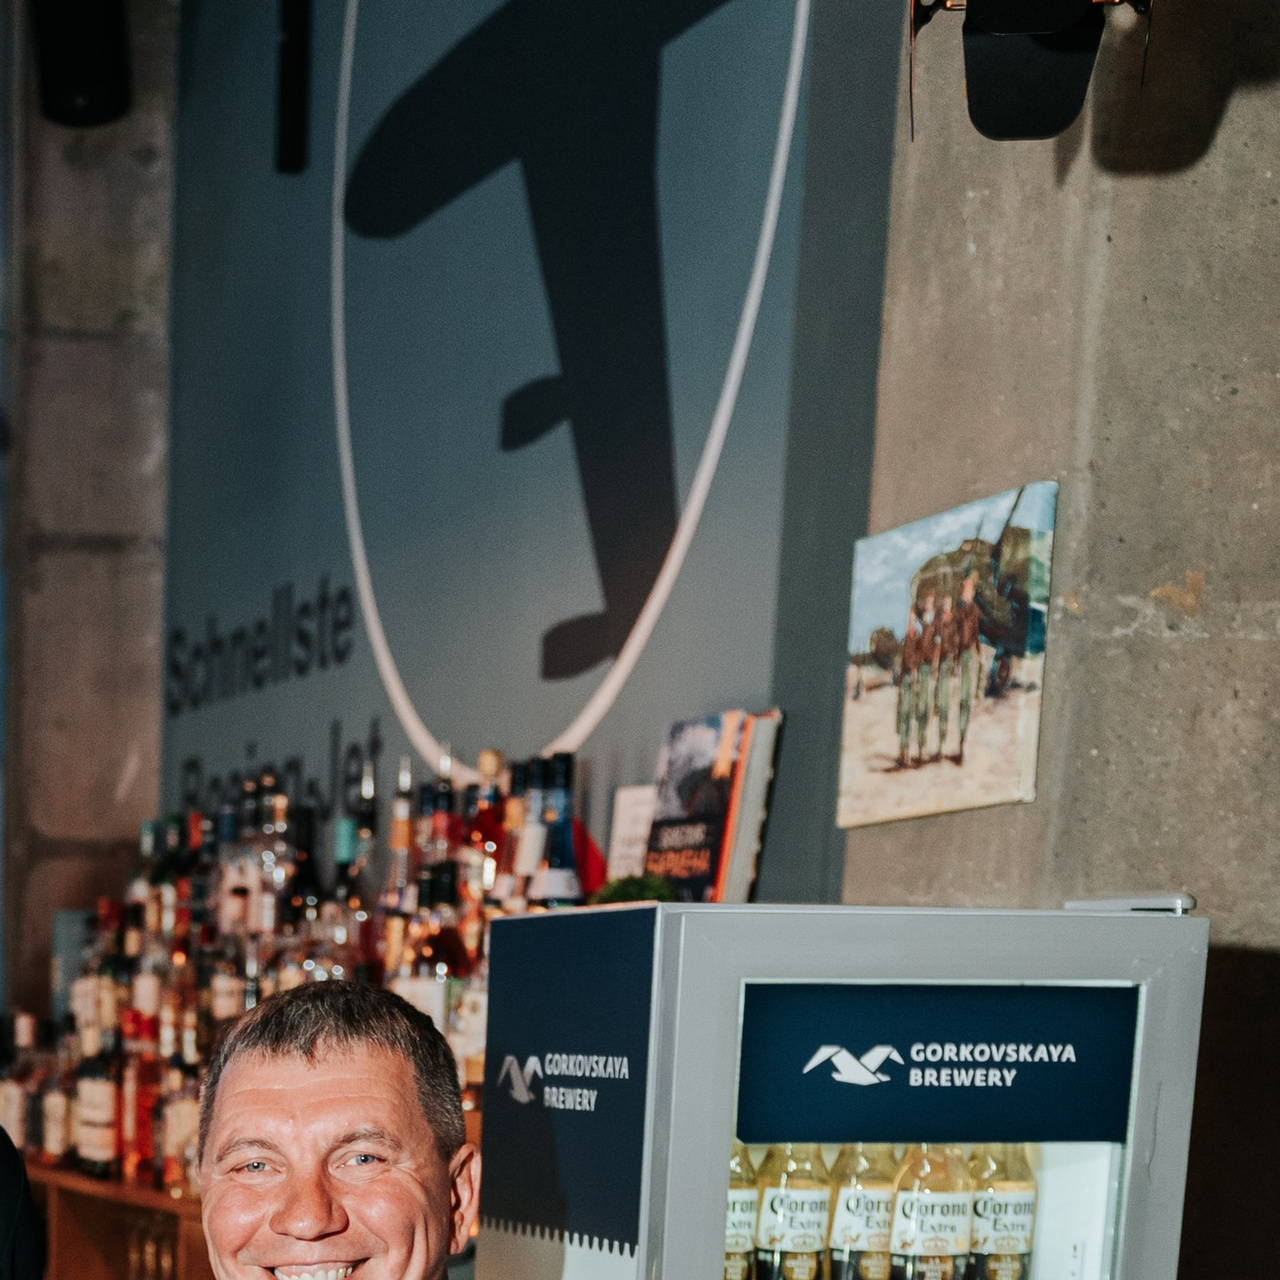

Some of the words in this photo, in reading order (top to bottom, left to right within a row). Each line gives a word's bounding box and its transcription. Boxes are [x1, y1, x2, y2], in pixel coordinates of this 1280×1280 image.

[166, 576, 355, 716] Schnellste
[910, 1042, 1077, 1063] GORKOVSKAYA
[544, 1052, 629, 1080] GORKOVSKAYA
[909, 1069, 1017, 1087] BREWERY
[543, 1085, 598, 1112] BREWERY
[770, 1194, 829, 1220] Coron
[972, 1198, 1034, 1219] Coron
